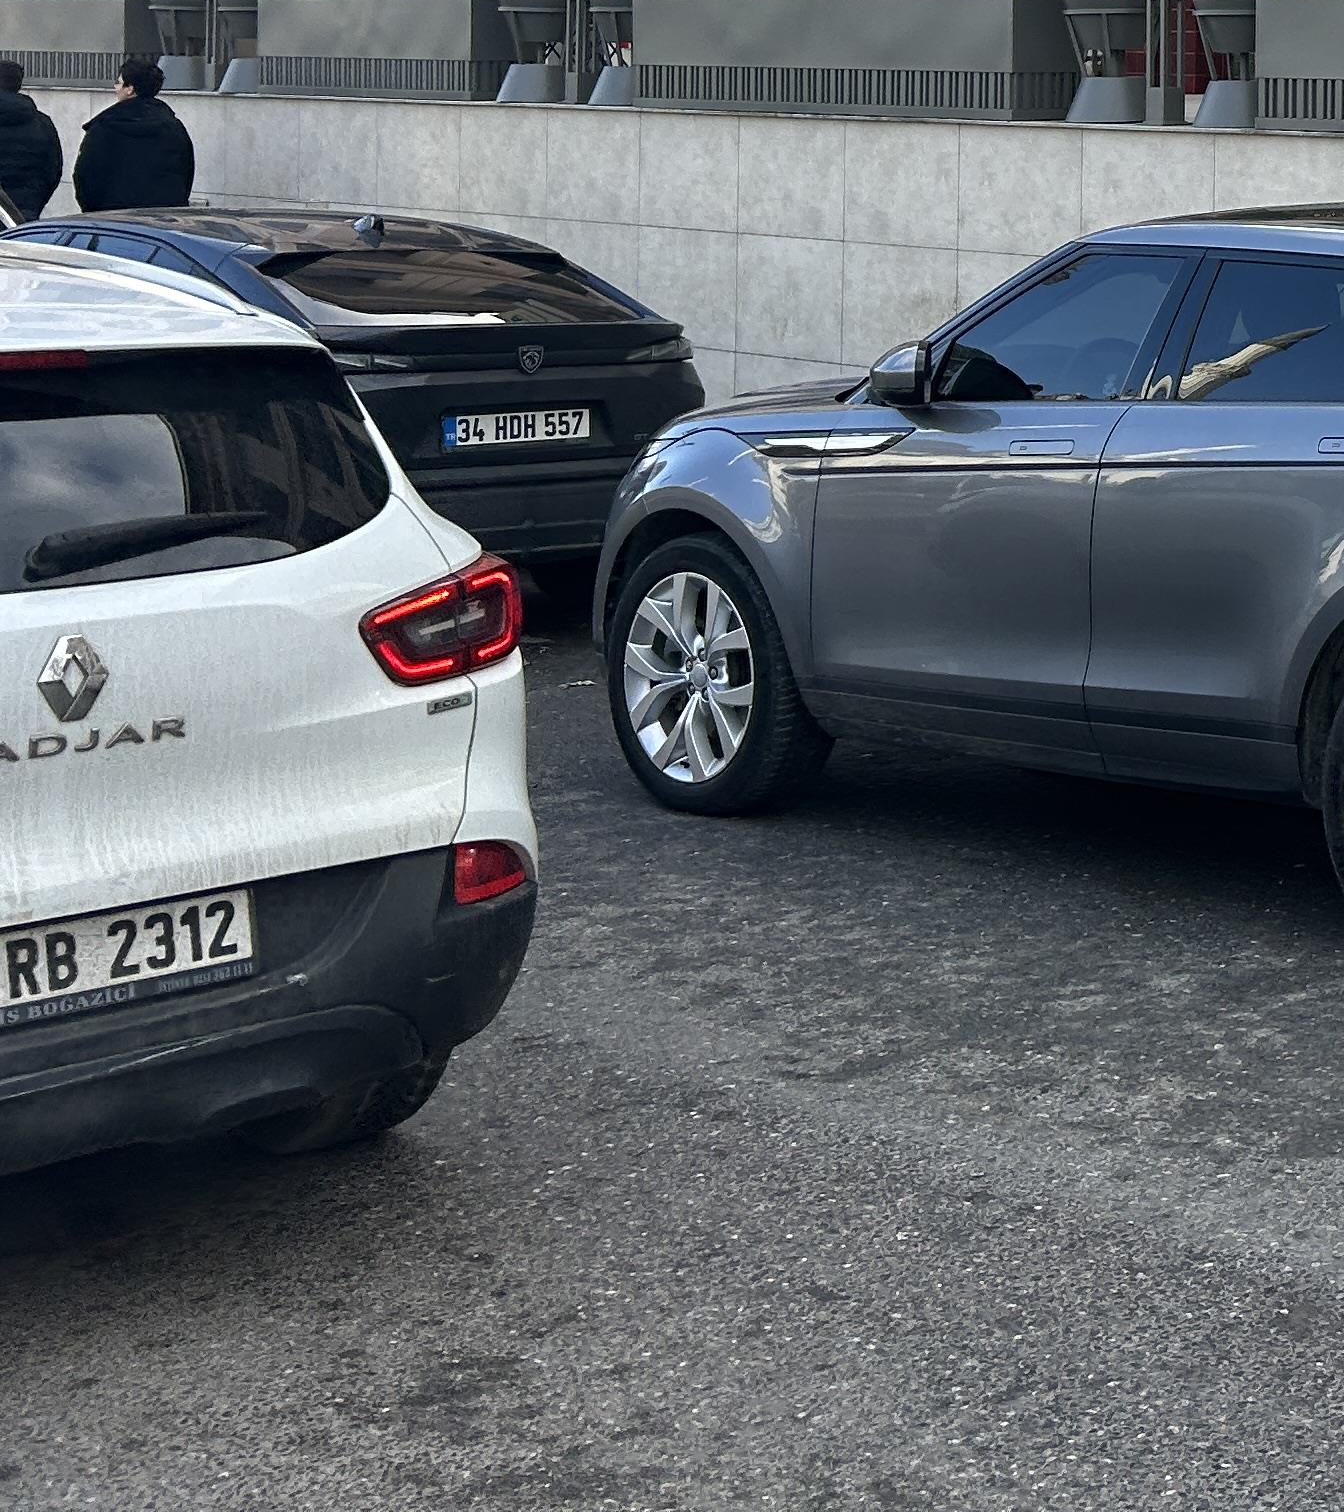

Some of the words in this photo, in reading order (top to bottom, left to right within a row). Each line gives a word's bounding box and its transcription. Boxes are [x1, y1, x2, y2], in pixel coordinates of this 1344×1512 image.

[457, 417, 485, 443] 34
[495, 414, 536, 440] HDH
[544, 411, 584, 437] 557
[6, 932, 79, 999] RB
[107, 900, 238, 979] 2312
